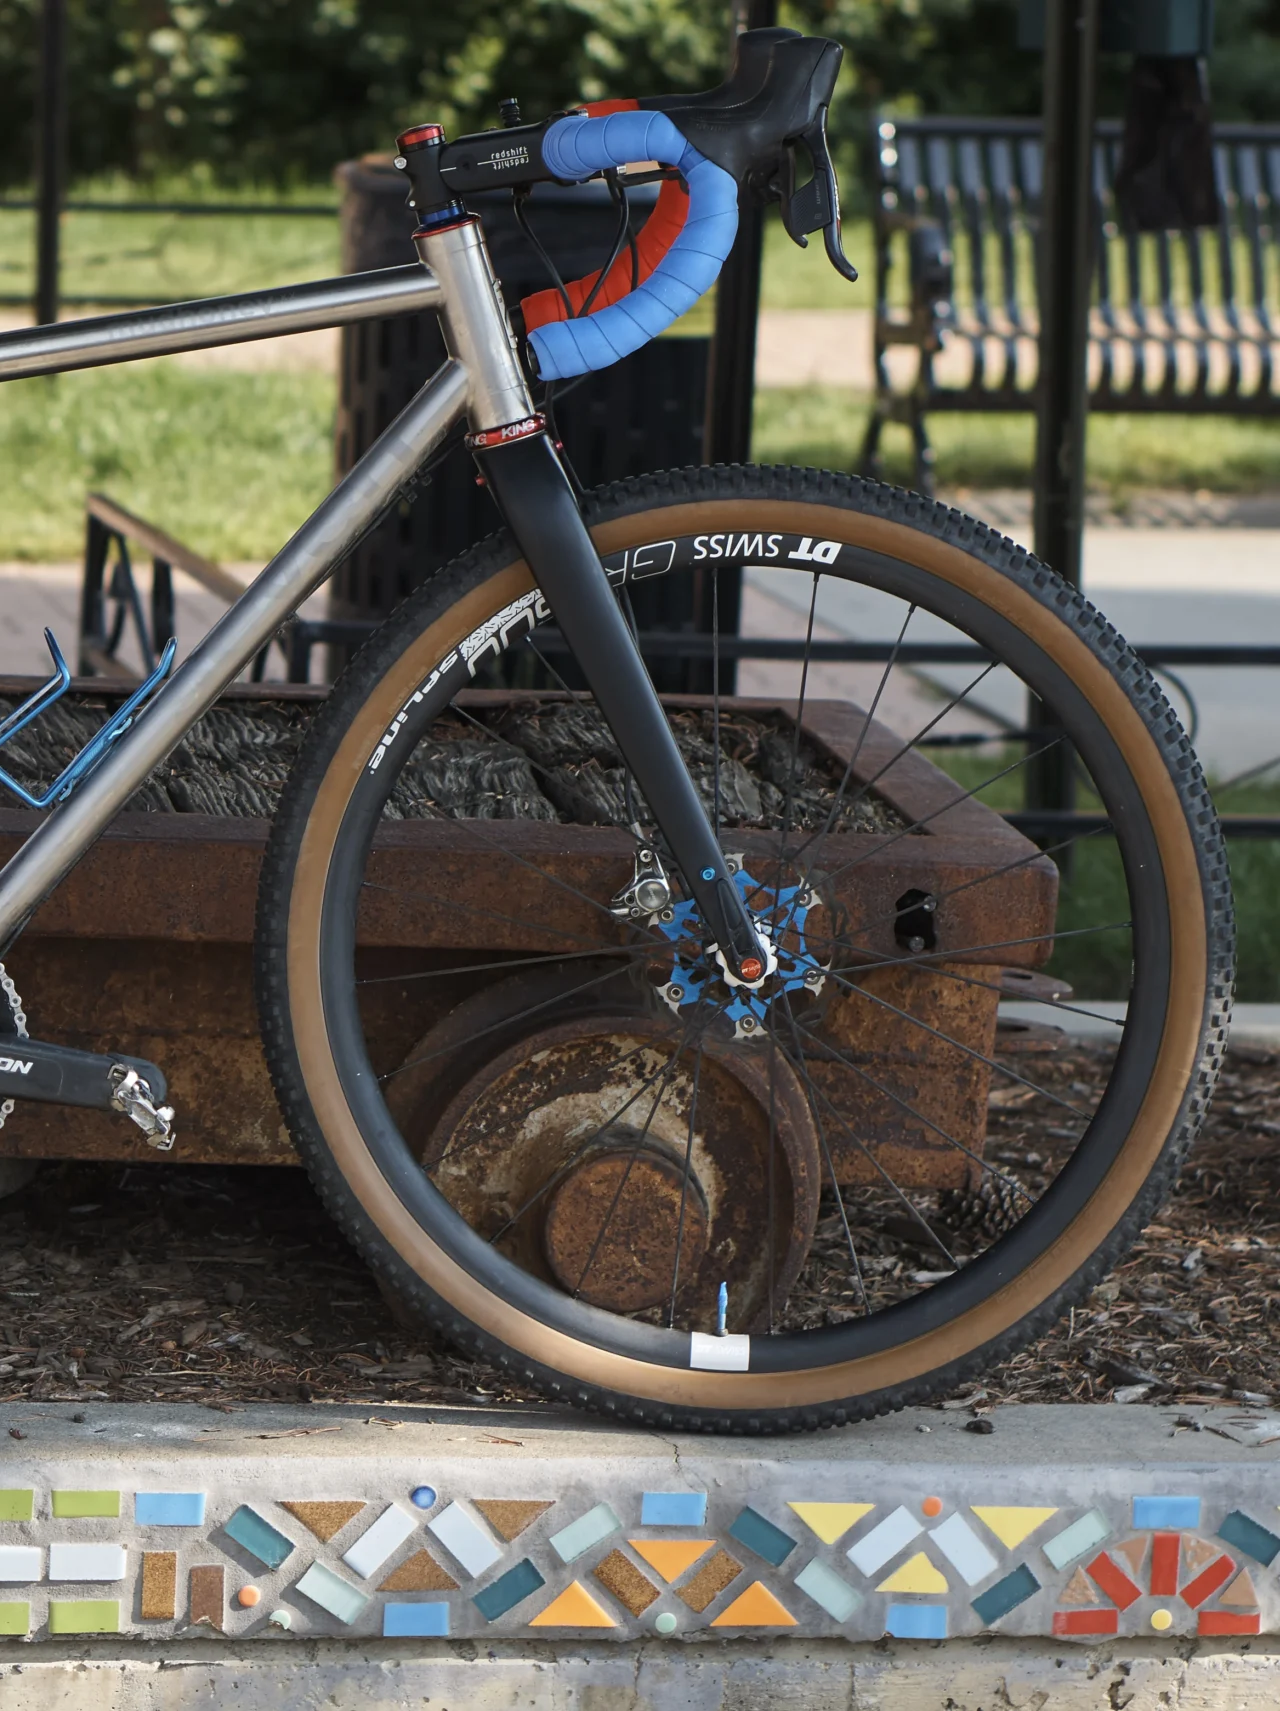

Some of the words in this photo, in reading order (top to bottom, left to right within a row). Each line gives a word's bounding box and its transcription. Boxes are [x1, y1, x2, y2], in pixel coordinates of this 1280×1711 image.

[490, 145, 529, 161] redshift
[501, 418, 536, 440] KING
[693, 534, 783, 559] SWISS
[788, 537, 842, 564] DT
